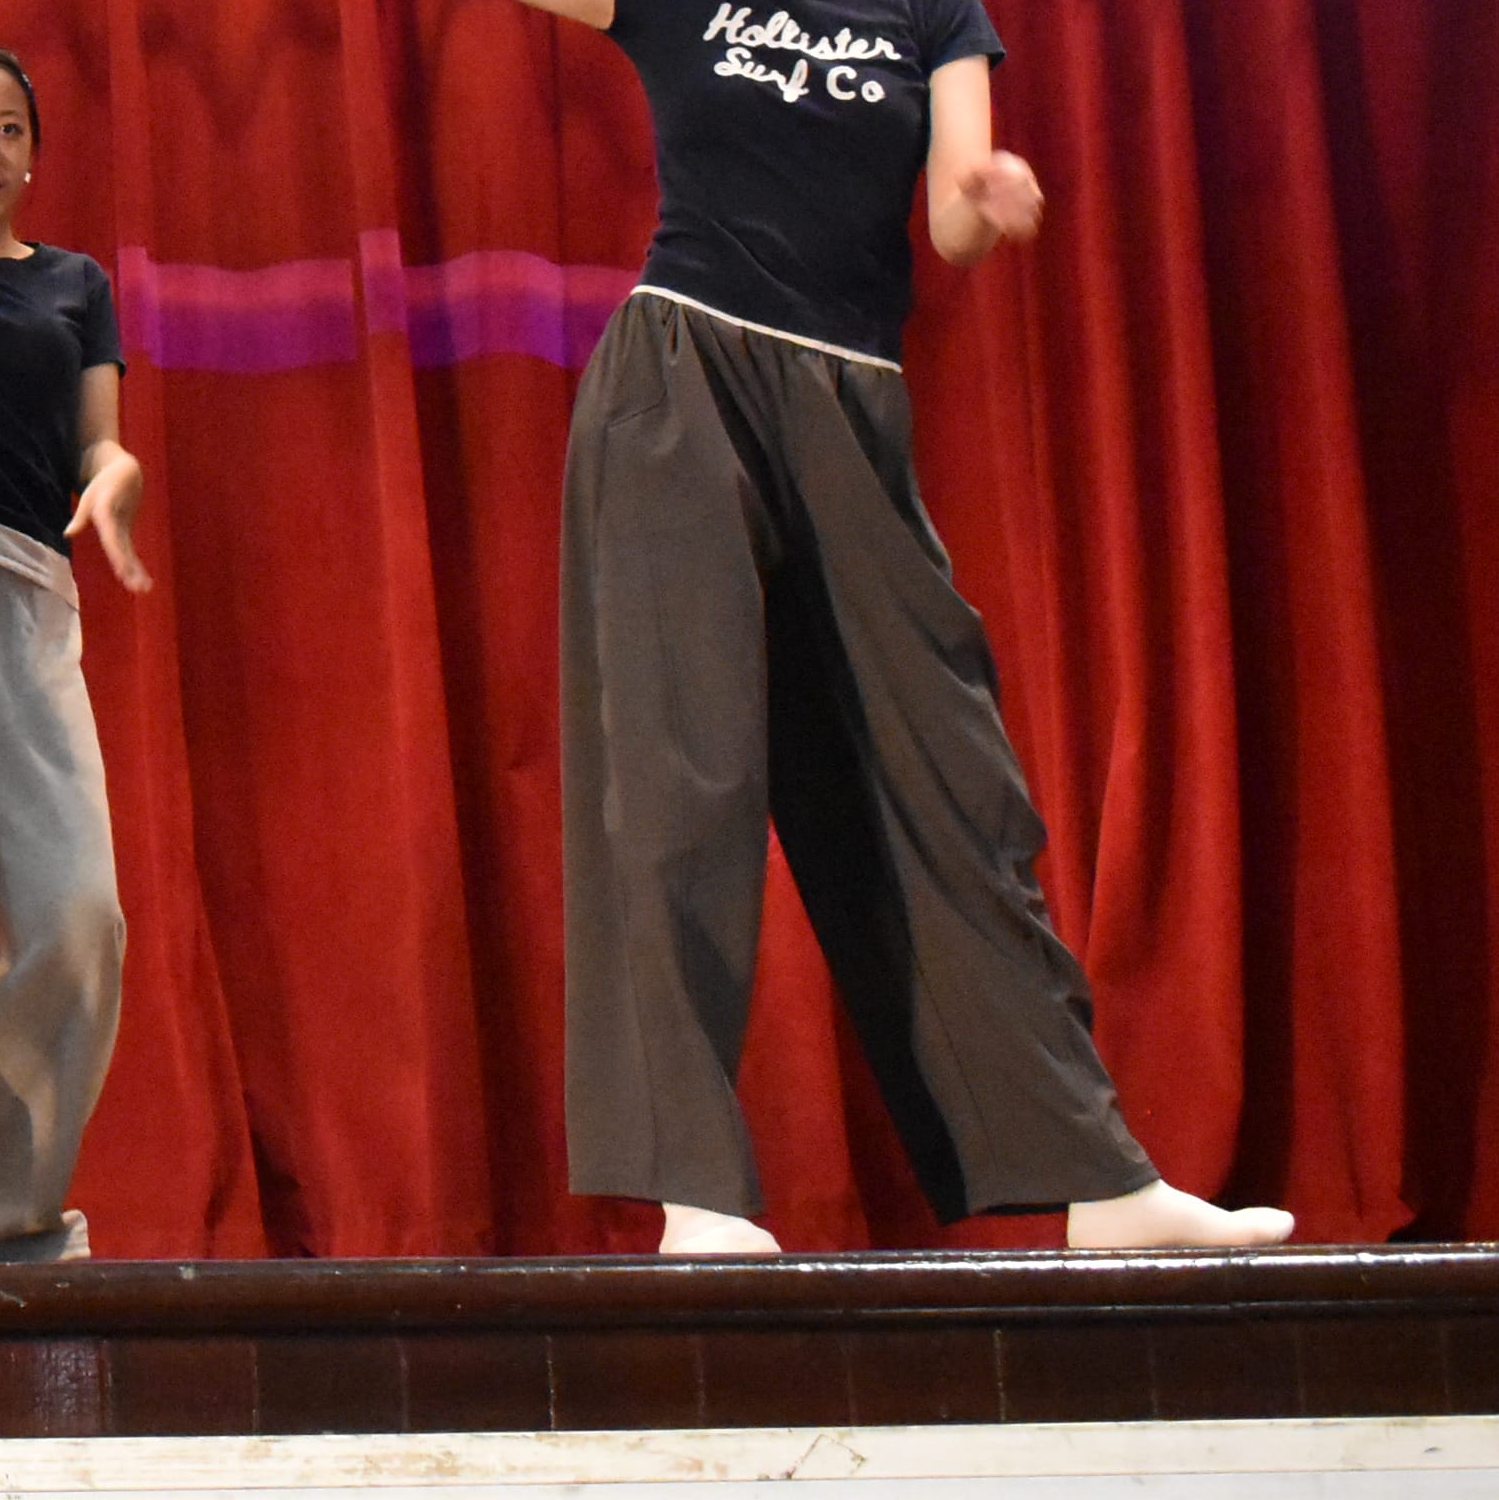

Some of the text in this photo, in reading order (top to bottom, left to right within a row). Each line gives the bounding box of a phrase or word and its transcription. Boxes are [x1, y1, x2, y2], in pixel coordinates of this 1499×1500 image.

[703, 2, 902, 61] Hollister
[714, 47, 887, 103] Surf Co
